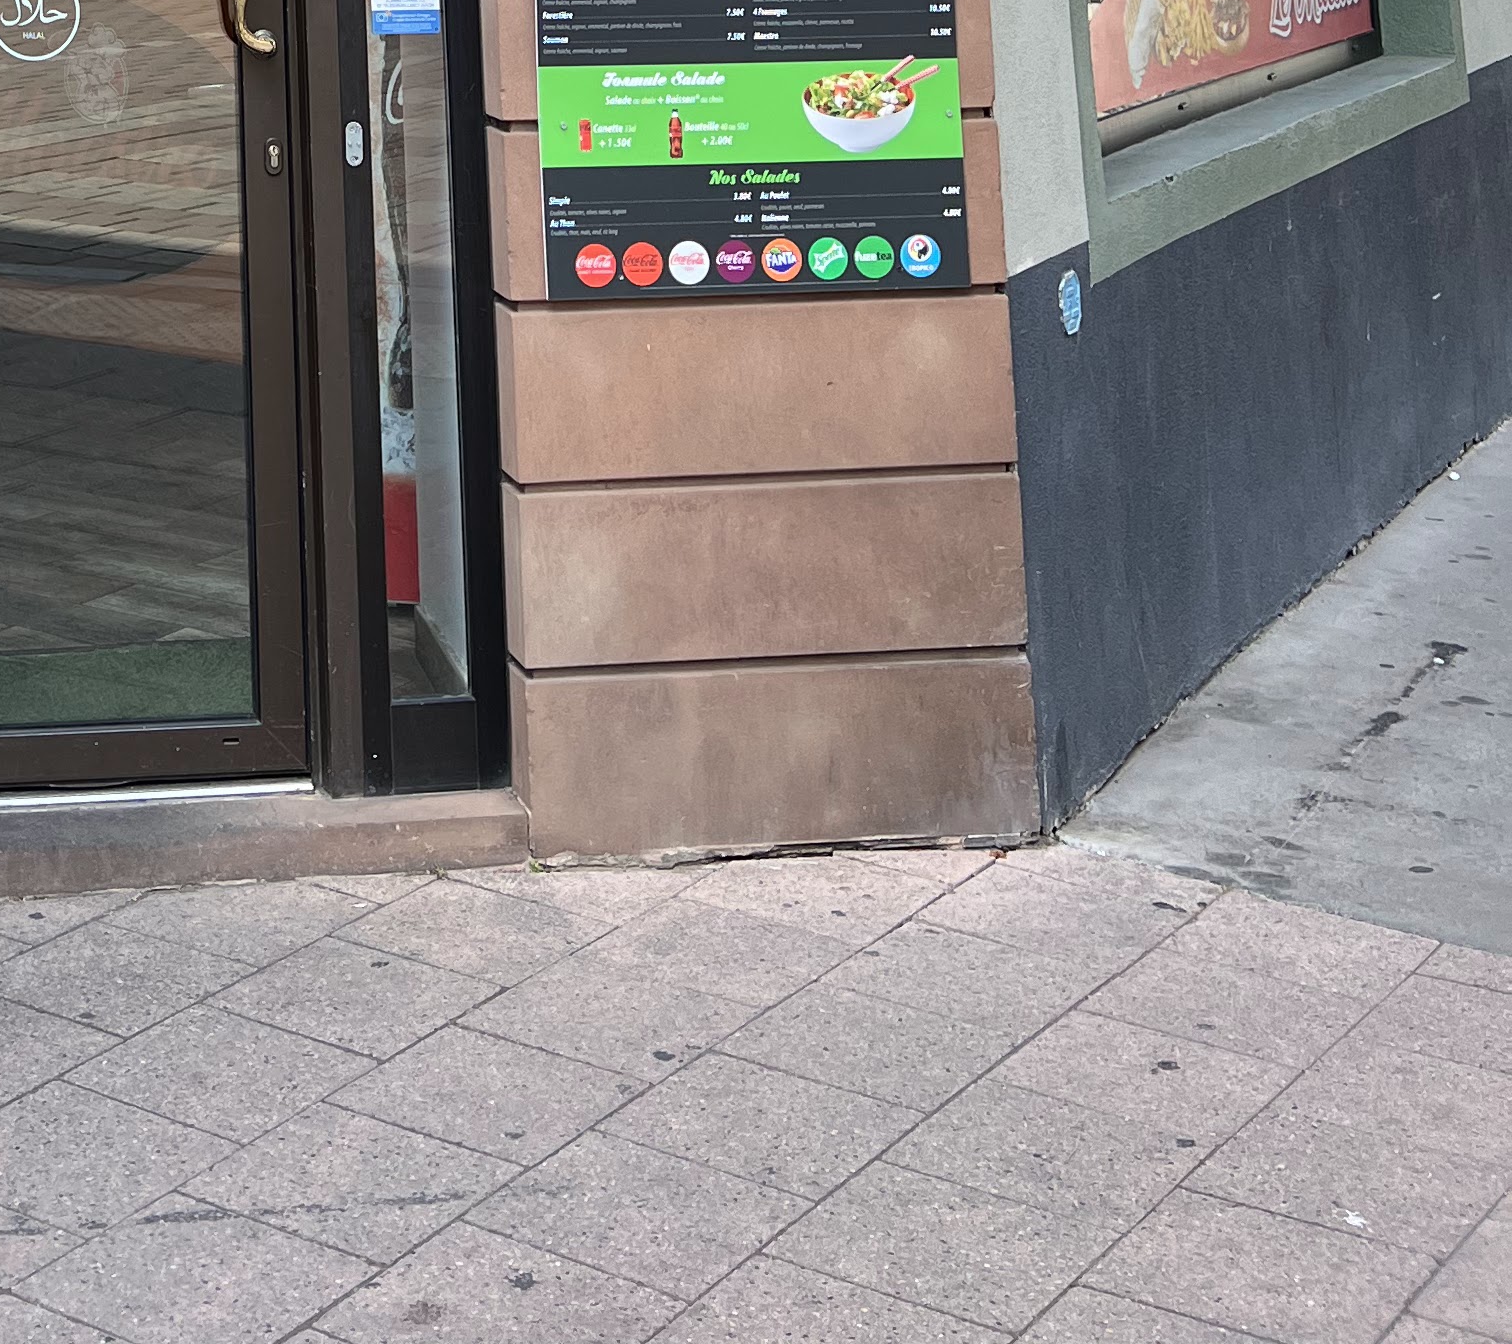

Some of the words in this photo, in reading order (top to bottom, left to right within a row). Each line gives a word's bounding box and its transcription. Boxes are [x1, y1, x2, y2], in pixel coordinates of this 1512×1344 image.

[23, 31, 45, 40] HALAL
[602, 73, 667, 88] Formule
[671, 71, 725, 86] Salade
[709, 170, 736, 185] Nos
[741, 169, 800, 185] Salades
